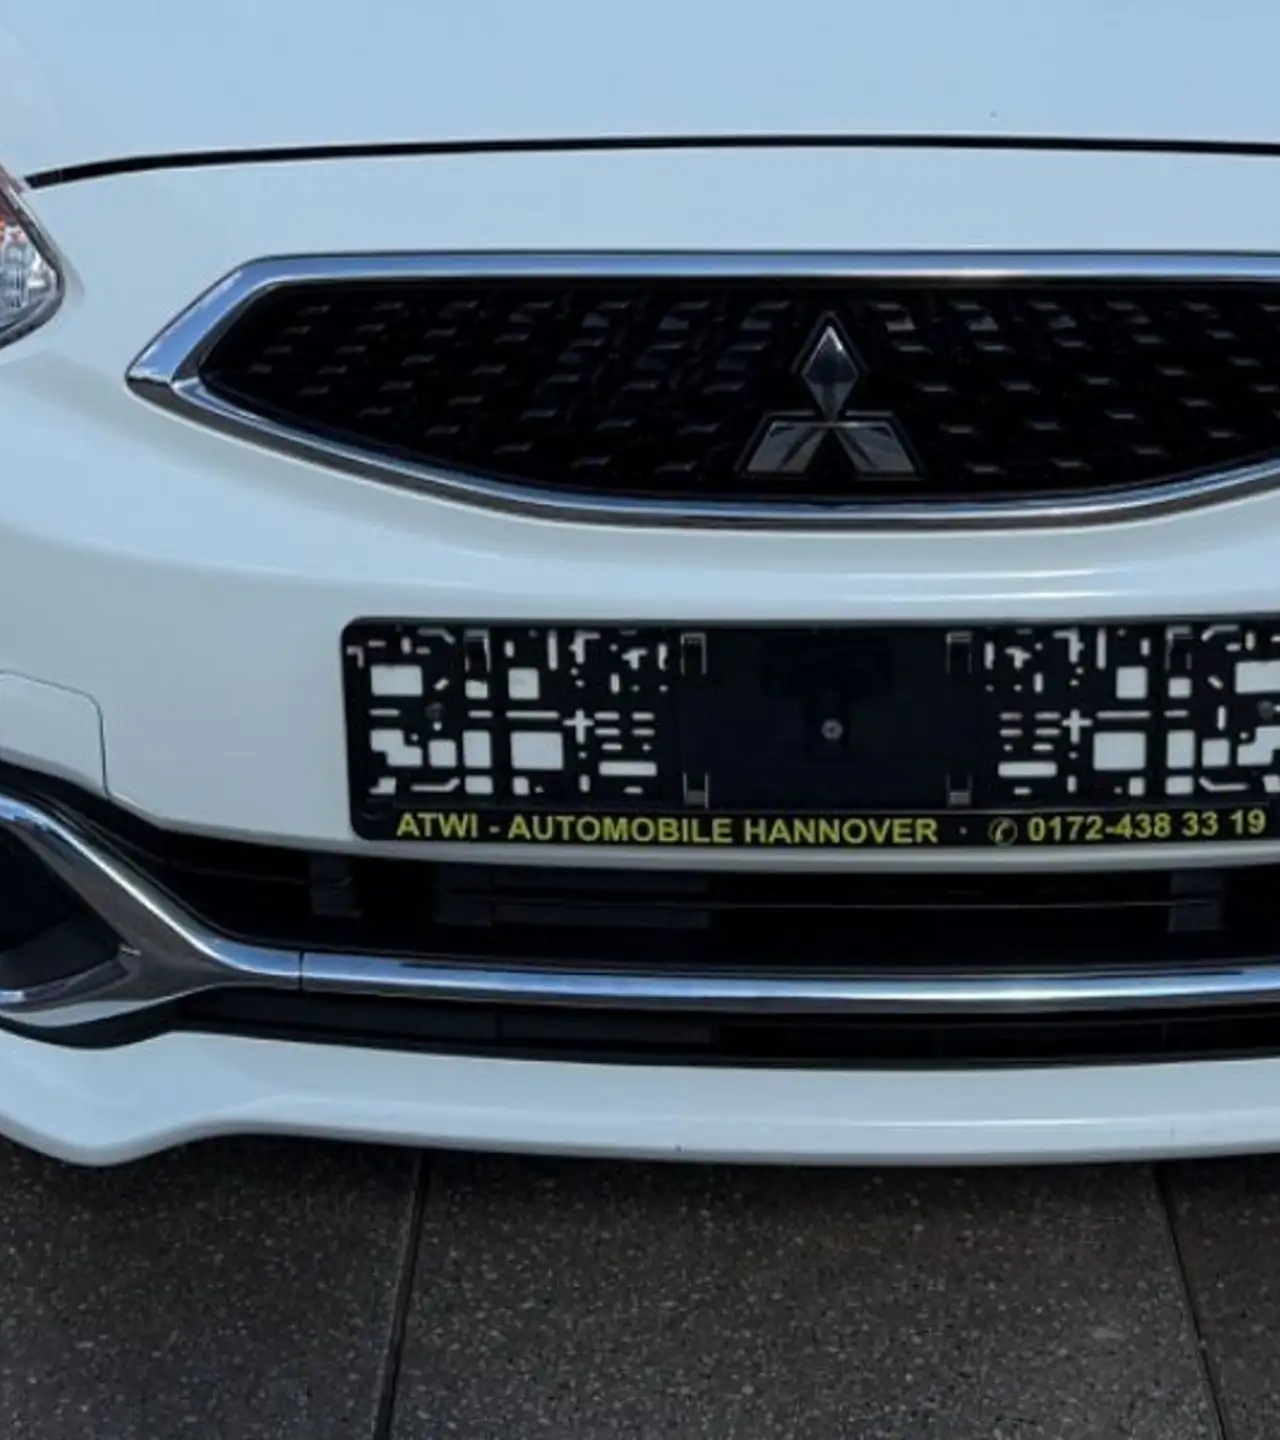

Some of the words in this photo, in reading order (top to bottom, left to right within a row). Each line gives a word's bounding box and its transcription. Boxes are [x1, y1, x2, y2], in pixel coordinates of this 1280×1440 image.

[396, 812, 479, 839] ATWI
[508, 814, 733, 843] AUTOMOBILE
[743, 817, 939, 845] HANNOVER
[1027, 812, 1172, 842] 0172-438
[1181, 810, 1219, 839] 33
[1229, 808, 1267, 836] 19
